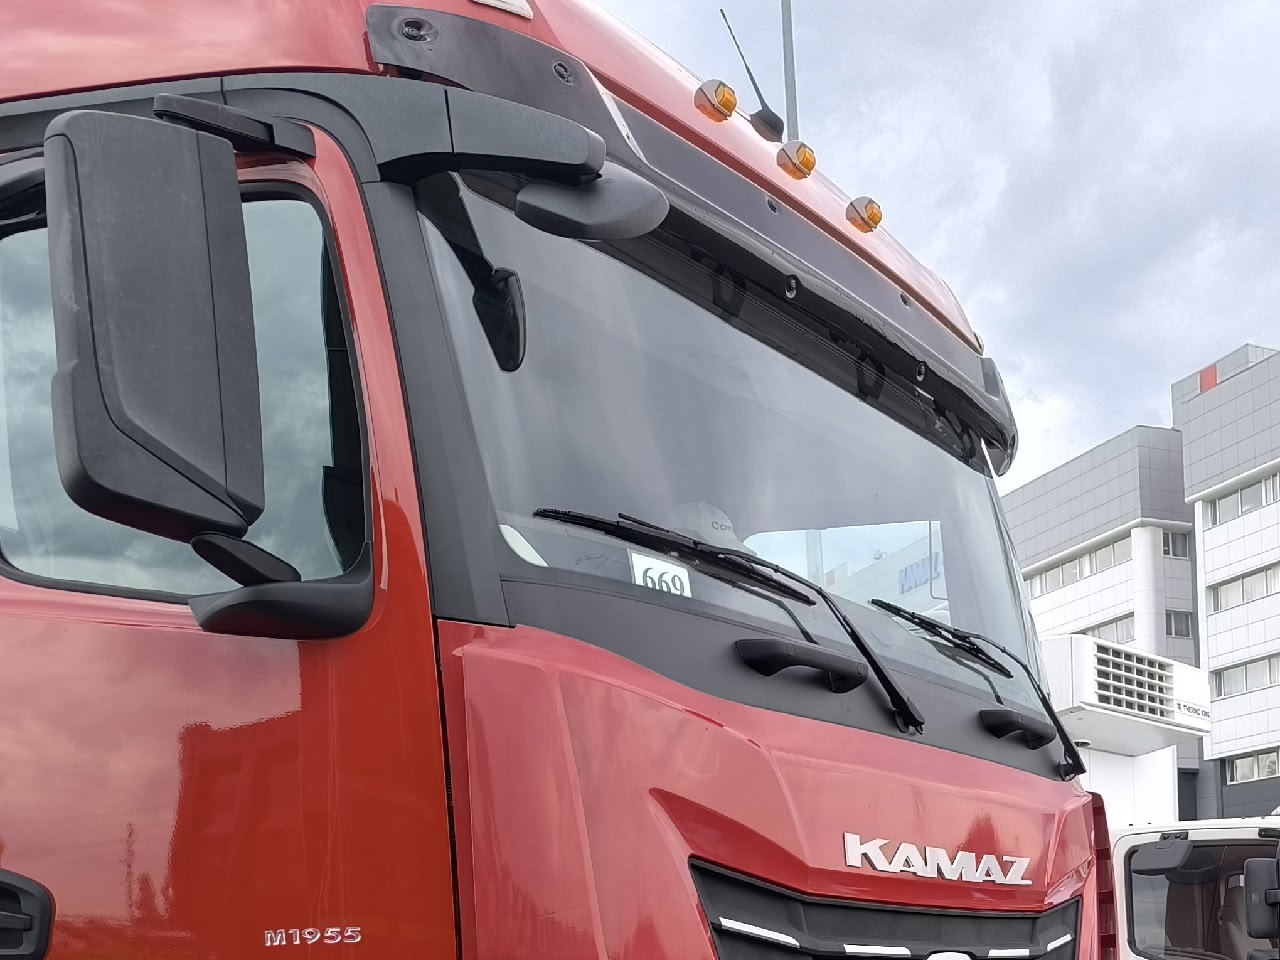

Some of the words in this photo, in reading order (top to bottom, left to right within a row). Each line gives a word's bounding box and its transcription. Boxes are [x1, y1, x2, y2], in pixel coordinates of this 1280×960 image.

[642, 567, 685, 596] 669
[843, 831, 1033, 886] KAMAZ
[264, 926, 362, 947] M1955
